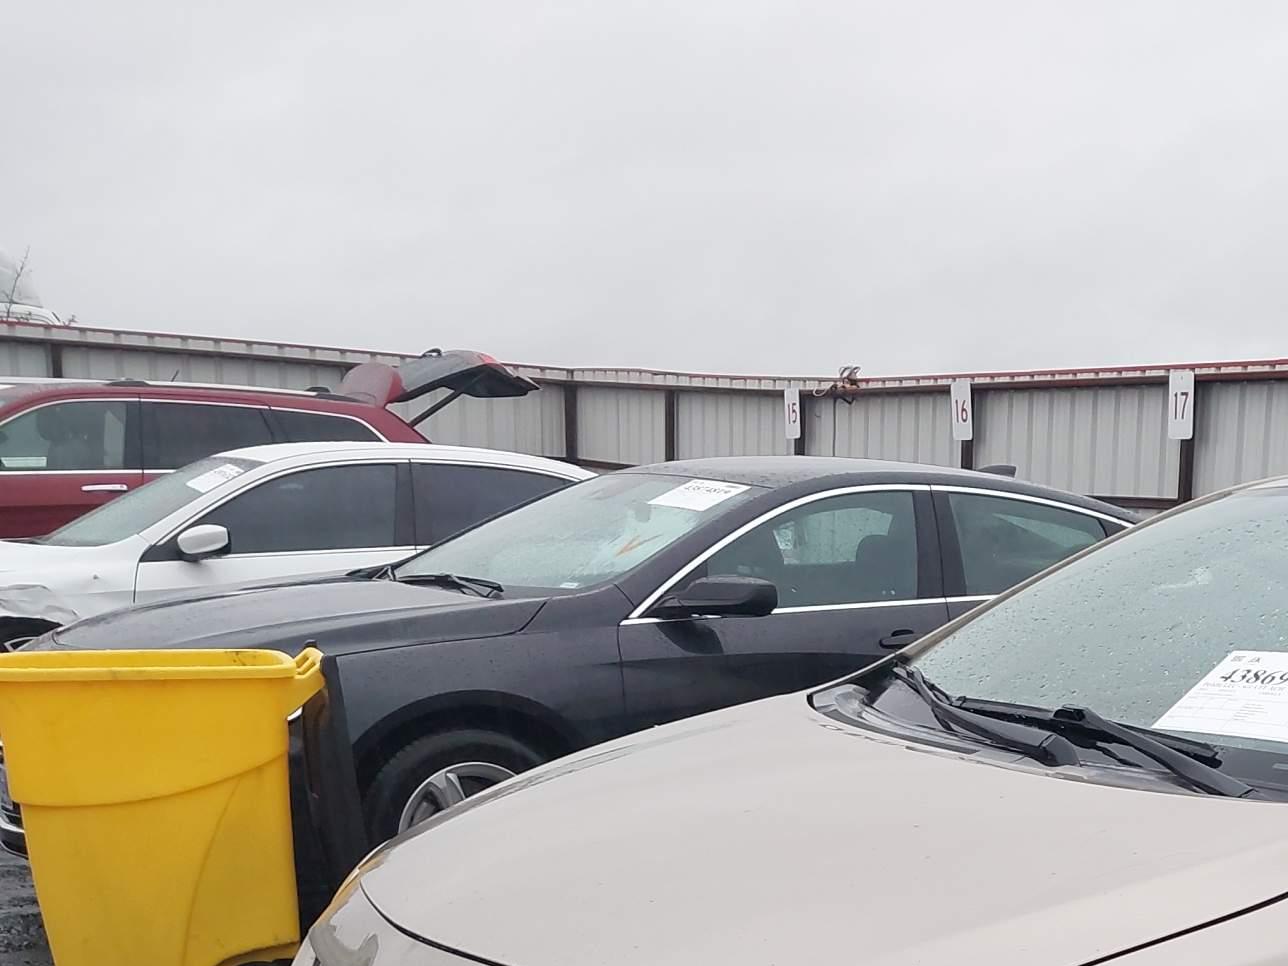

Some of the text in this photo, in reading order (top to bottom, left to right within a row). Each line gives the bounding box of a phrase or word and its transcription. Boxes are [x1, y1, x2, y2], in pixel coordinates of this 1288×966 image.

[787, 402, 797, 425] 15
[955, 399, 969, 423] 16
[1174, 391, 1189, 420] 17
